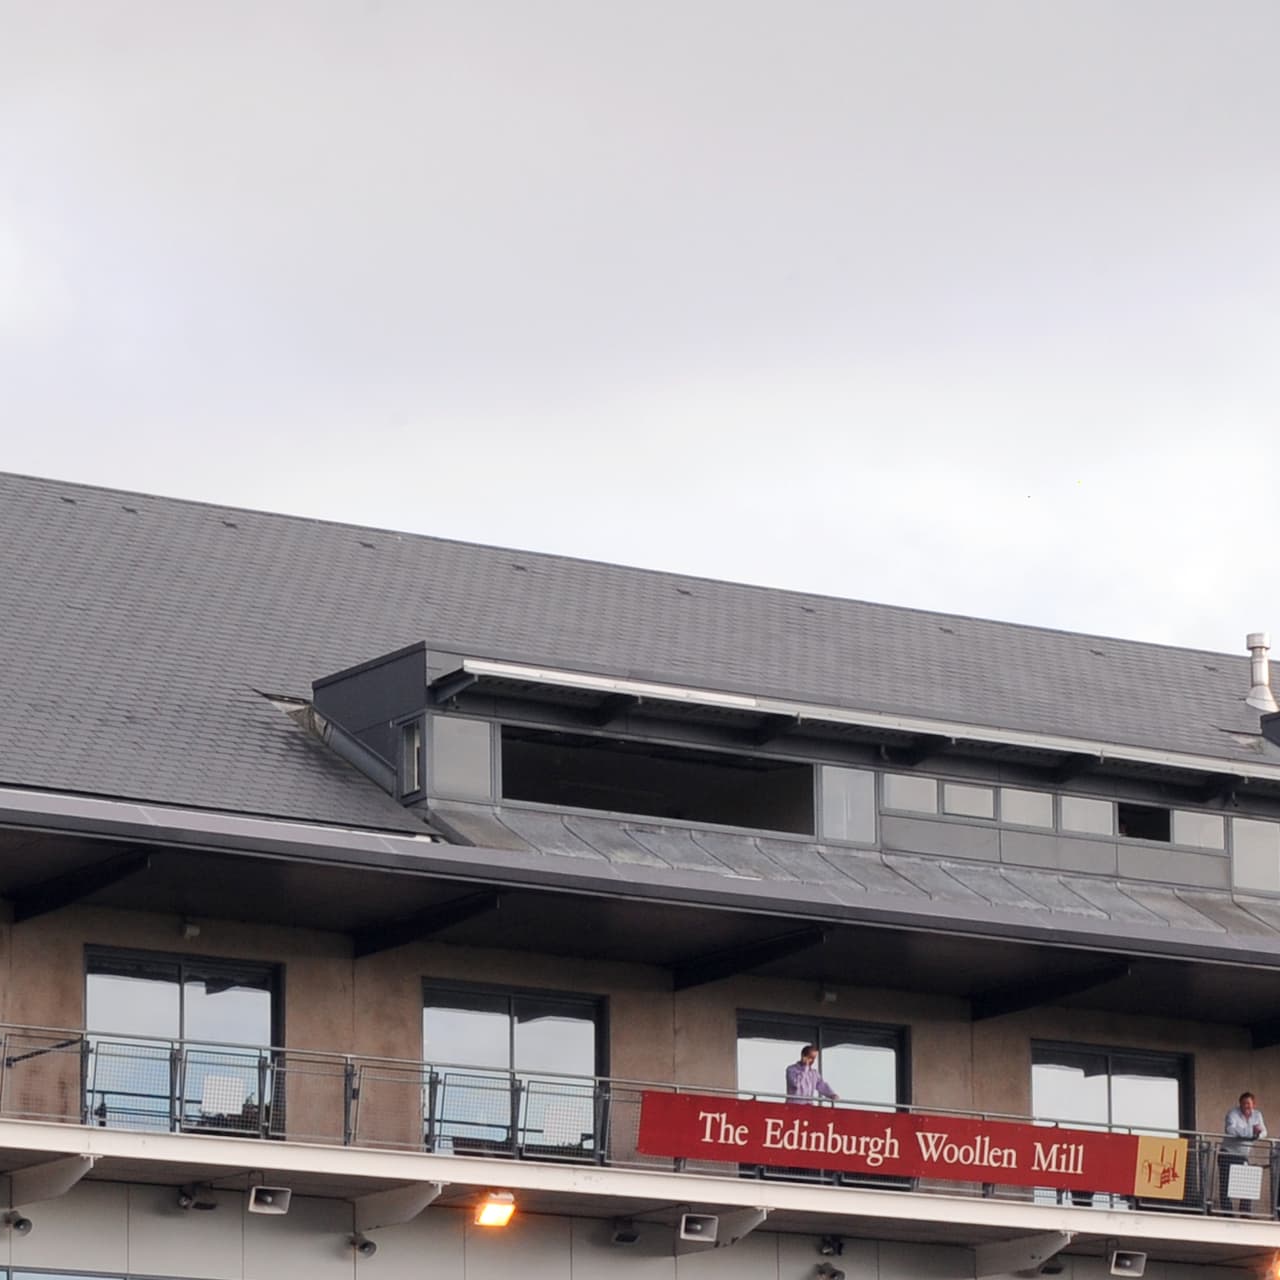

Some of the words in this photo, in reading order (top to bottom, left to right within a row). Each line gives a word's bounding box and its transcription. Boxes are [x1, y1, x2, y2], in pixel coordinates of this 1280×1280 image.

[698, 1111, 749, 1146] The
[762, 1117, 900, 1167] Edinburgh
[915, 1131, 1018, 1168] Woollen
[1030, 1142, 1084, 1174] Mill
